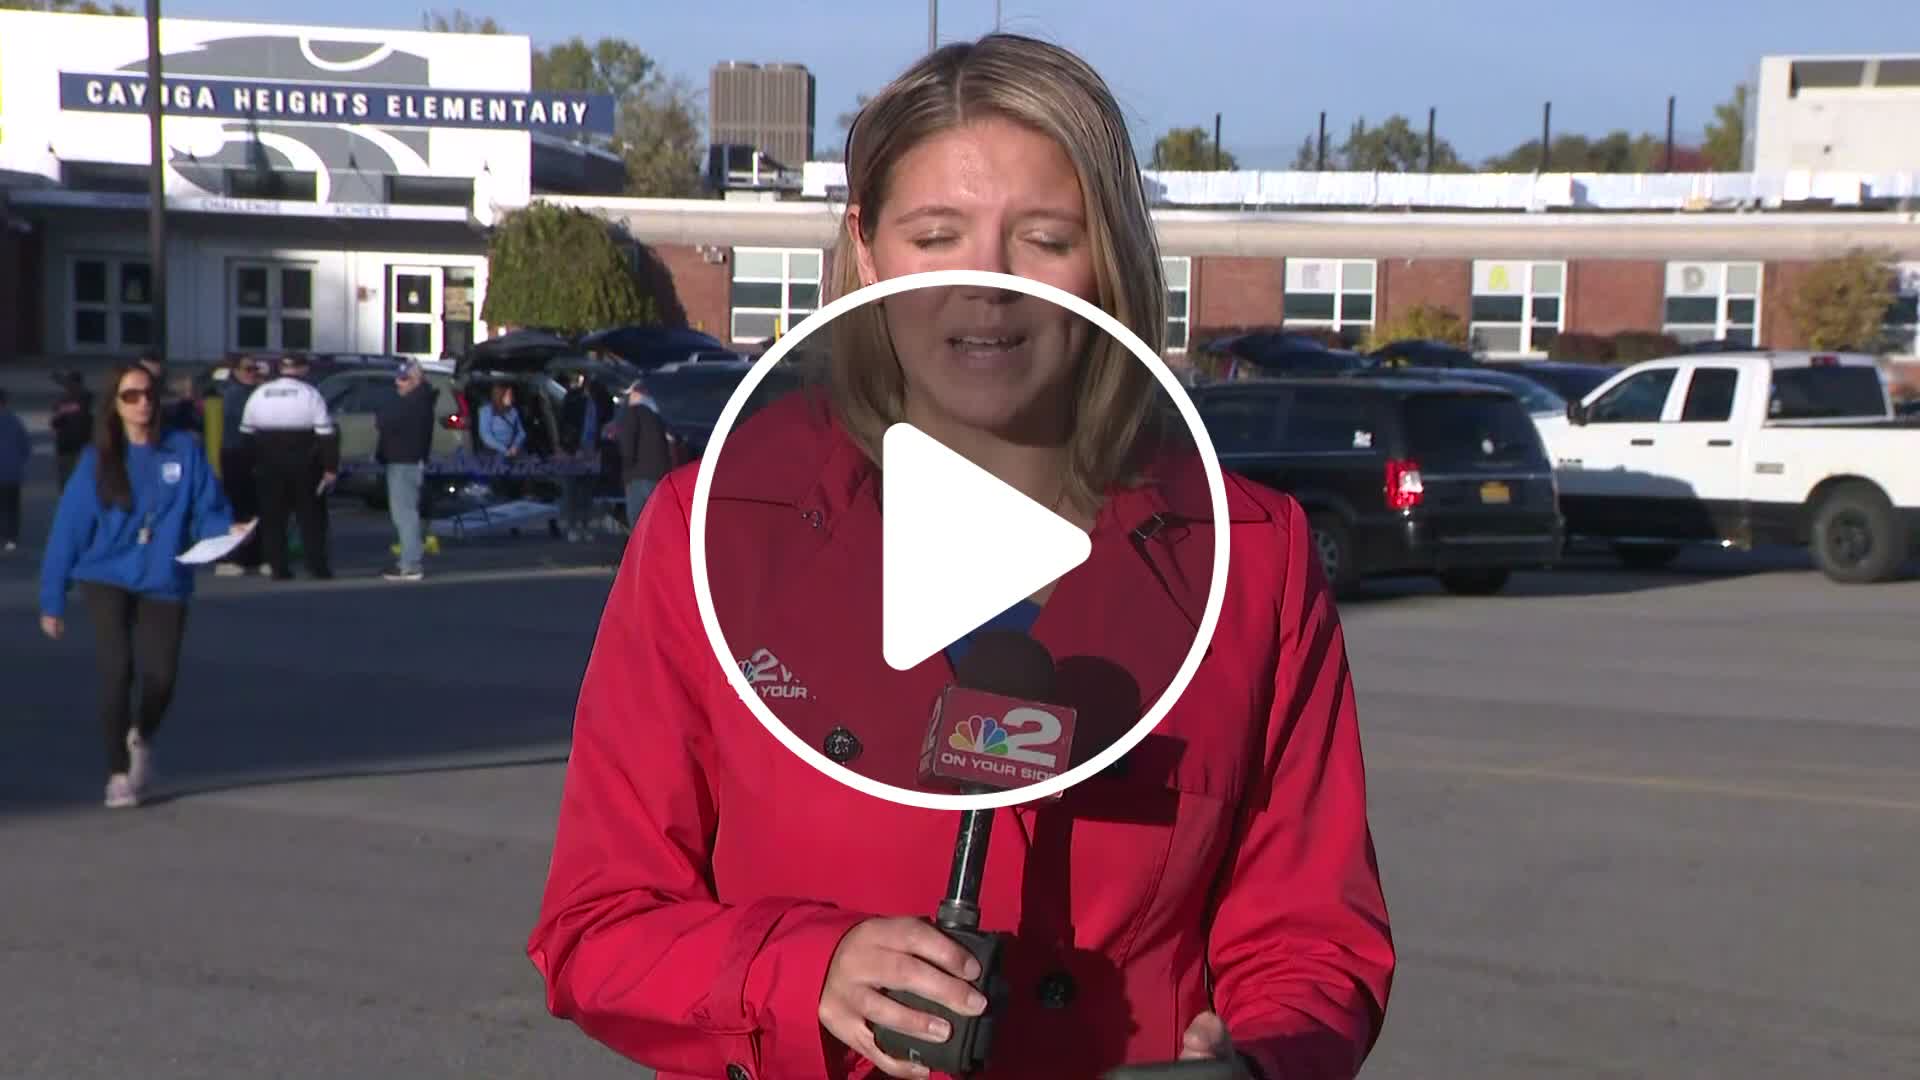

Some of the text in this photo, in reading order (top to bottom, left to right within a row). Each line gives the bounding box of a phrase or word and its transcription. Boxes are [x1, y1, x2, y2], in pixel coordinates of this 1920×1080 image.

[234, 87, 369, 117] HEIGHTS
[387, 94, 588, 125] ELEMENTARY
[761, 685, 808, 699] YOUR
[1002, 707, 1062, 769] 2
[941, 752, 967, 768] ON
[971, 757, 1017, 777] YOUR
